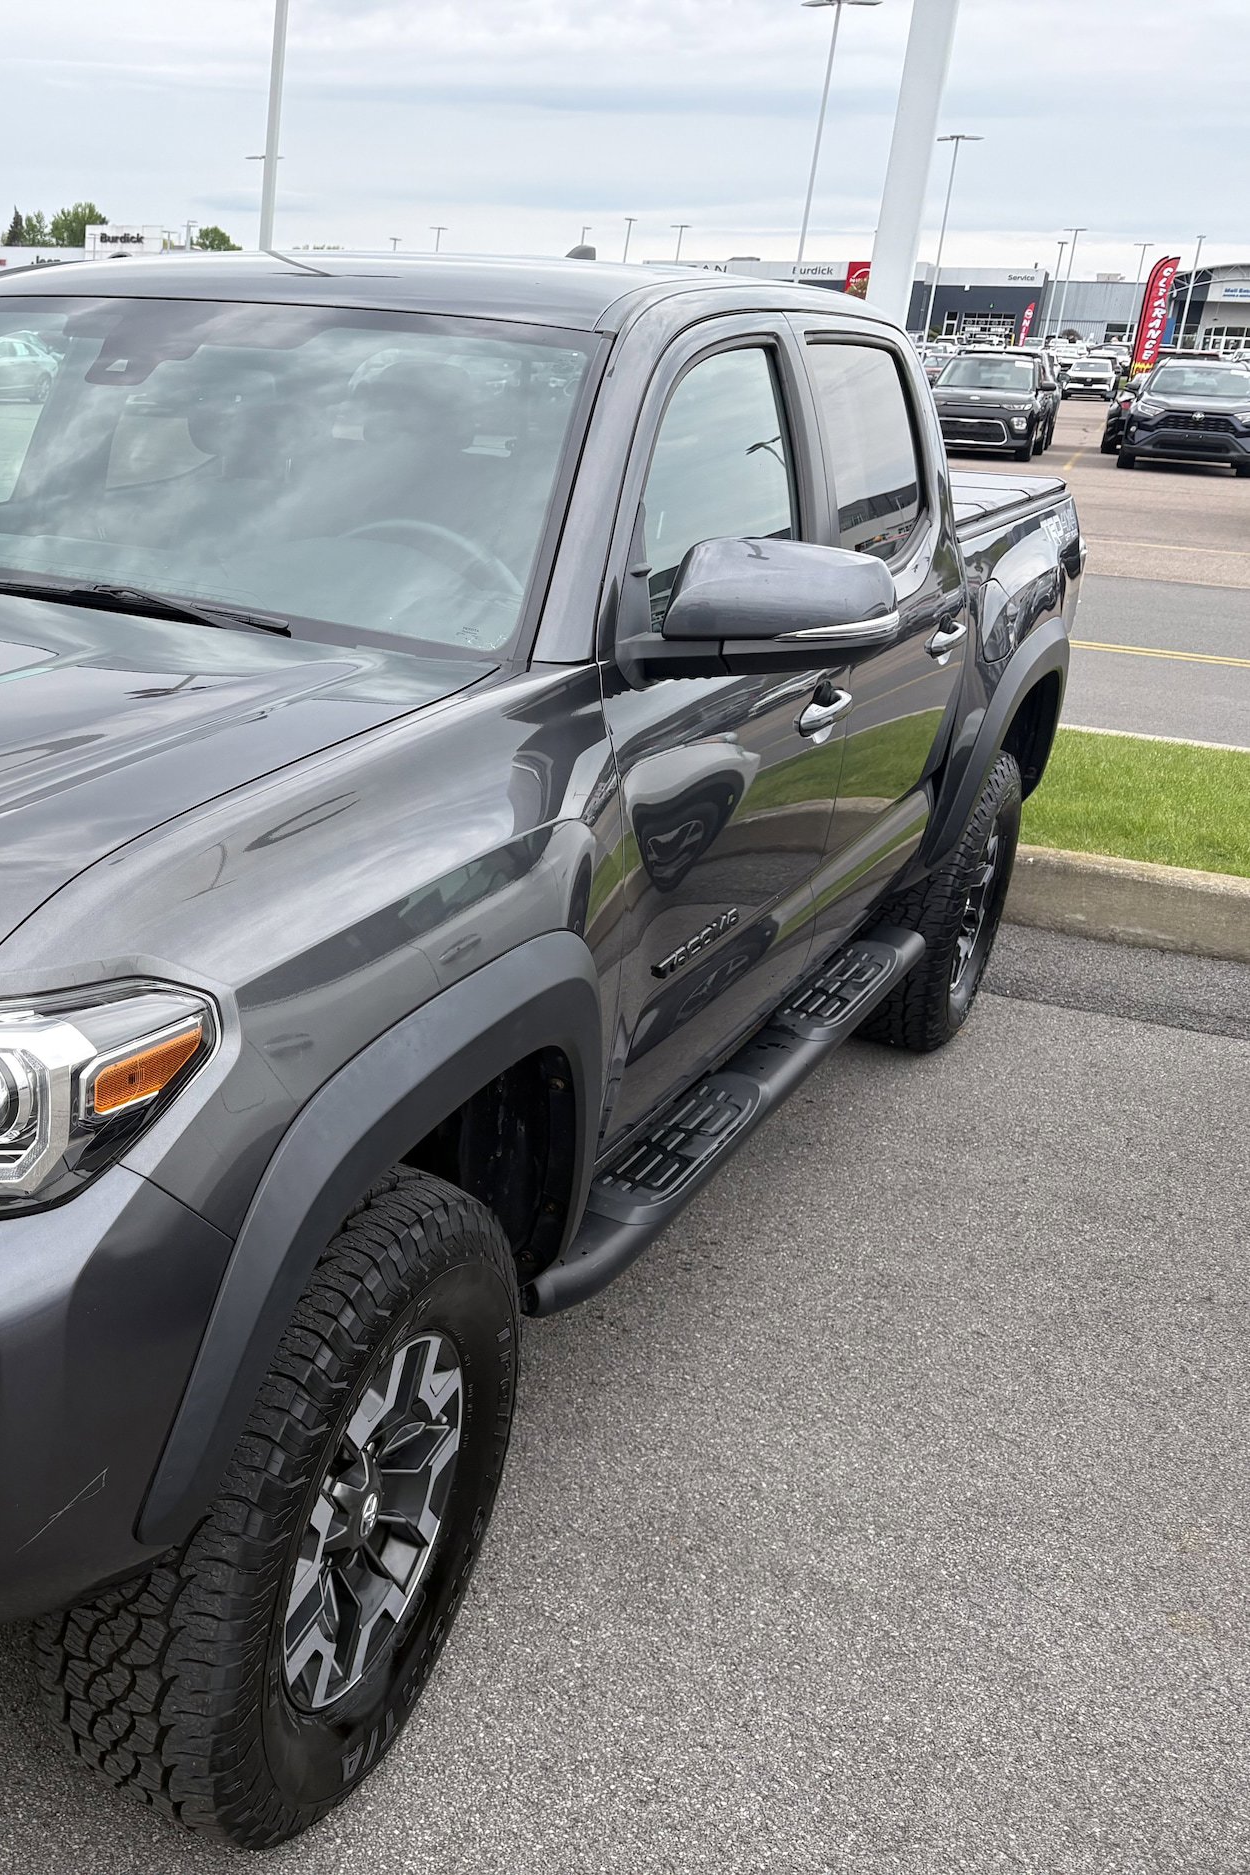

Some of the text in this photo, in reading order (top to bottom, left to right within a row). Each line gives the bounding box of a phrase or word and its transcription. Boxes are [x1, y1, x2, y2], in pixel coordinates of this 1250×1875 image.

[100, 232, 144, 244] Burdick
[31, 255, 61, 265] Jee
[1142, 267, 1174, 361] CLEARANCE
[1040, 514, 1064, 546] TRD
[651, 907, 740, 979] TACOMA
